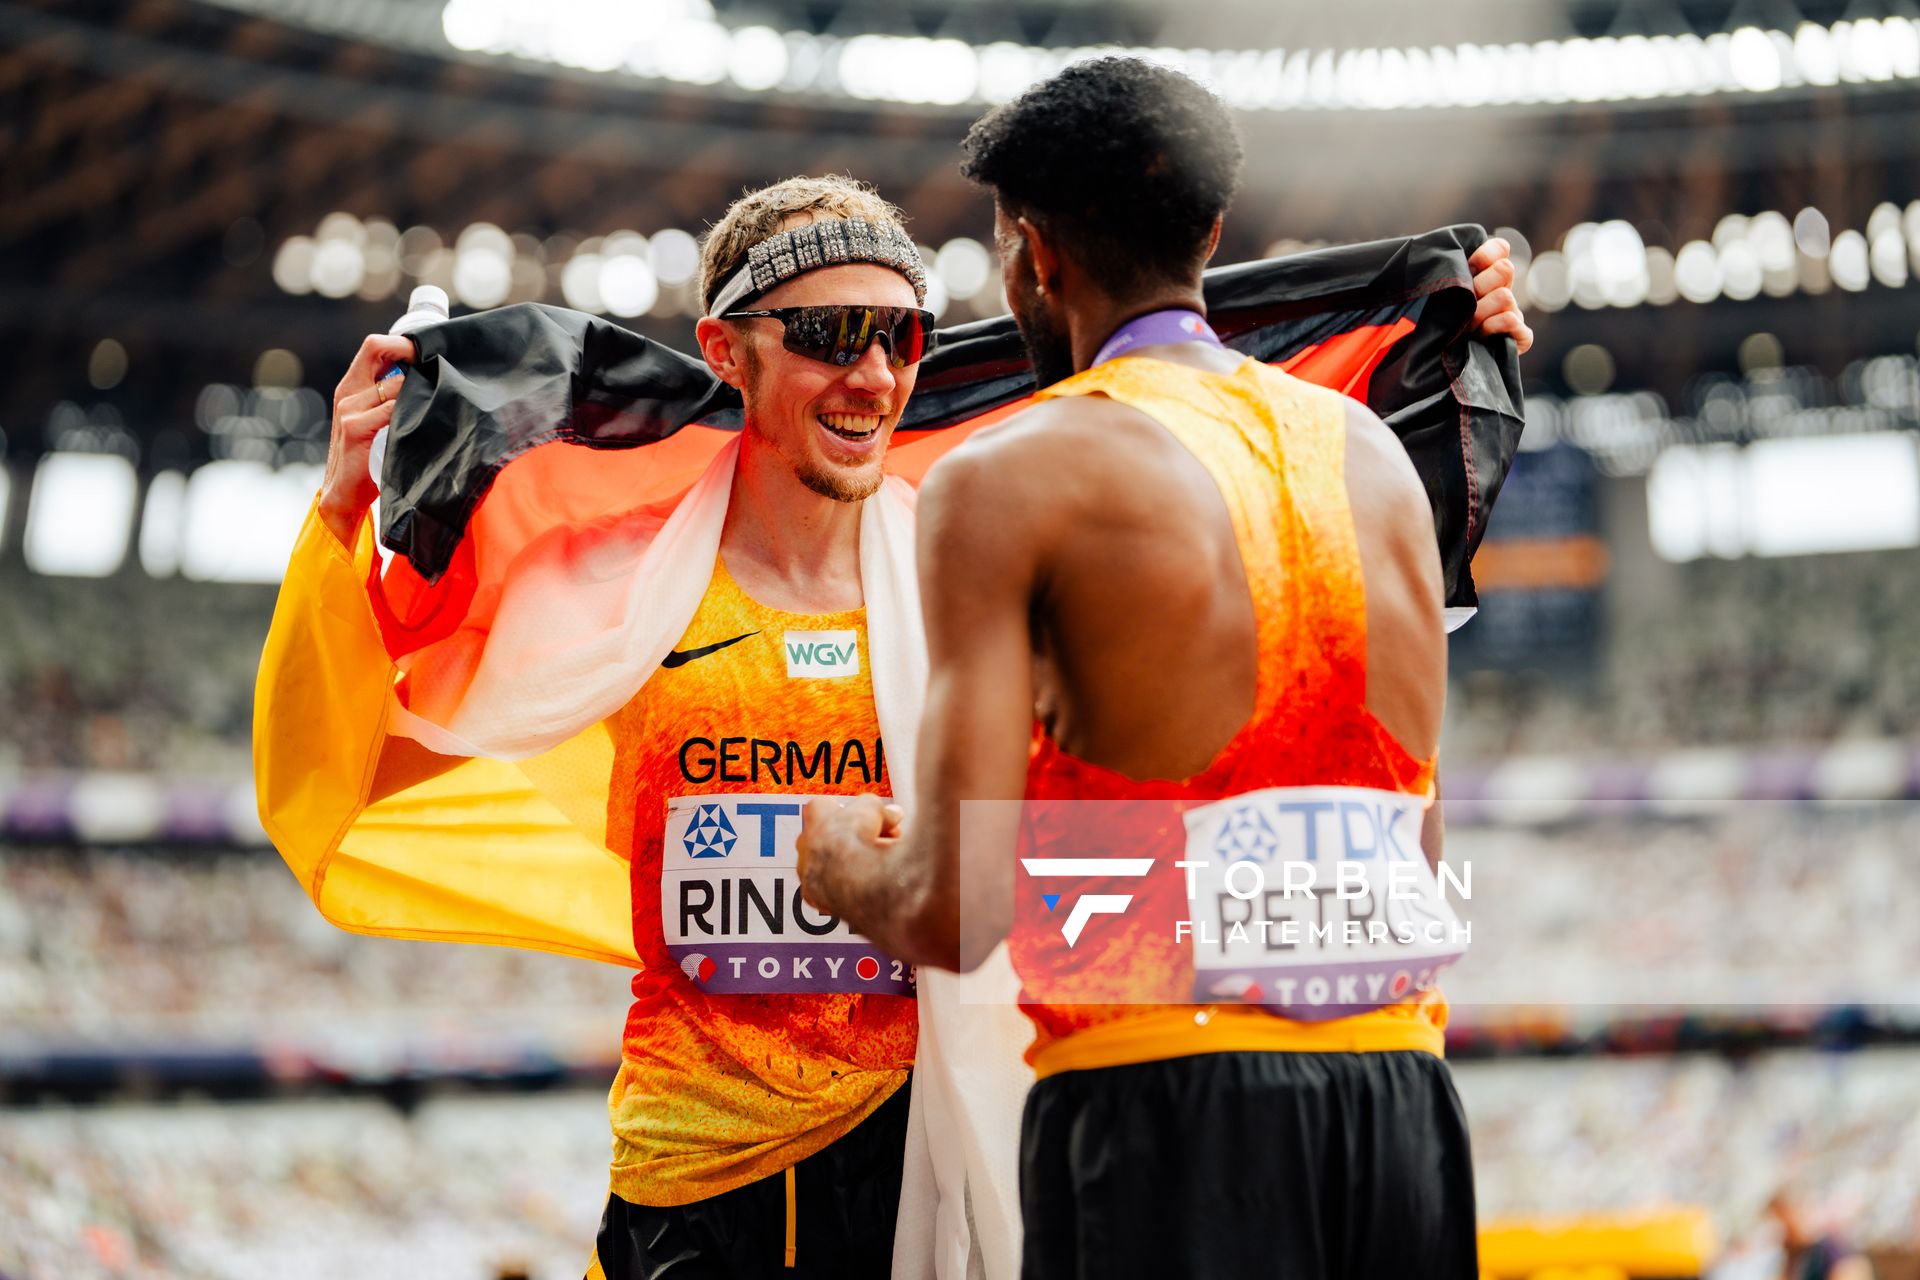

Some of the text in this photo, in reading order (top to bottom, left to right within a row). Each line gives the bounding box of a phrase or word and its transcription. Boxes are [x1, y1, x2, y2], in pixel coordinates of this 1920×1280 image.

[786, 641, 856, 667] WGV
[736, 803, 808, 857] T
[1278, 800, 1409, 862] TDK
[679, 878, 862, 936] RING
